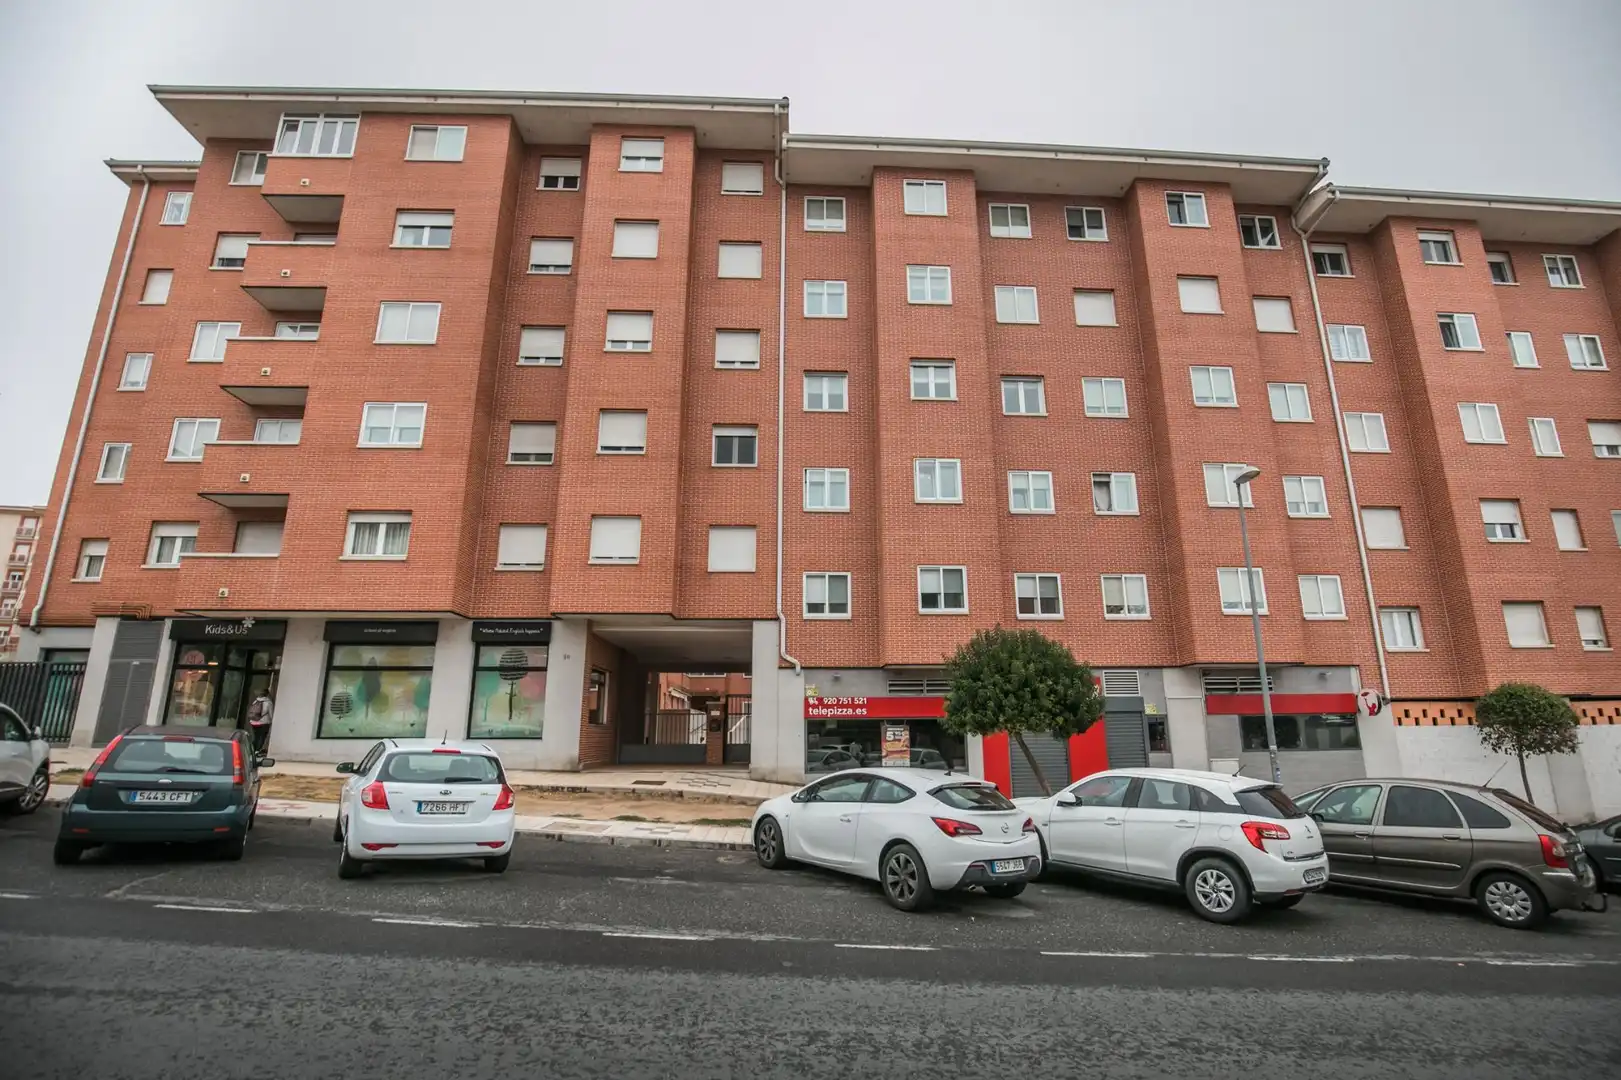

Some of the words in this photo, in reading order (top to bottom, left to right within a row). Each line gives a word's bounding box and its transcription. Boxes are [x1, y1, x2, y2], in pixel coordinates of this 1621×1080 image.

[205, 624, 248, 634] Kids&Us
[808, 706, 867, 717] telepizza.es
[139, 791, 167, 801] 5443
[169, 792, 190, 801] CFT
[423, 803, 447, 811] 7266
